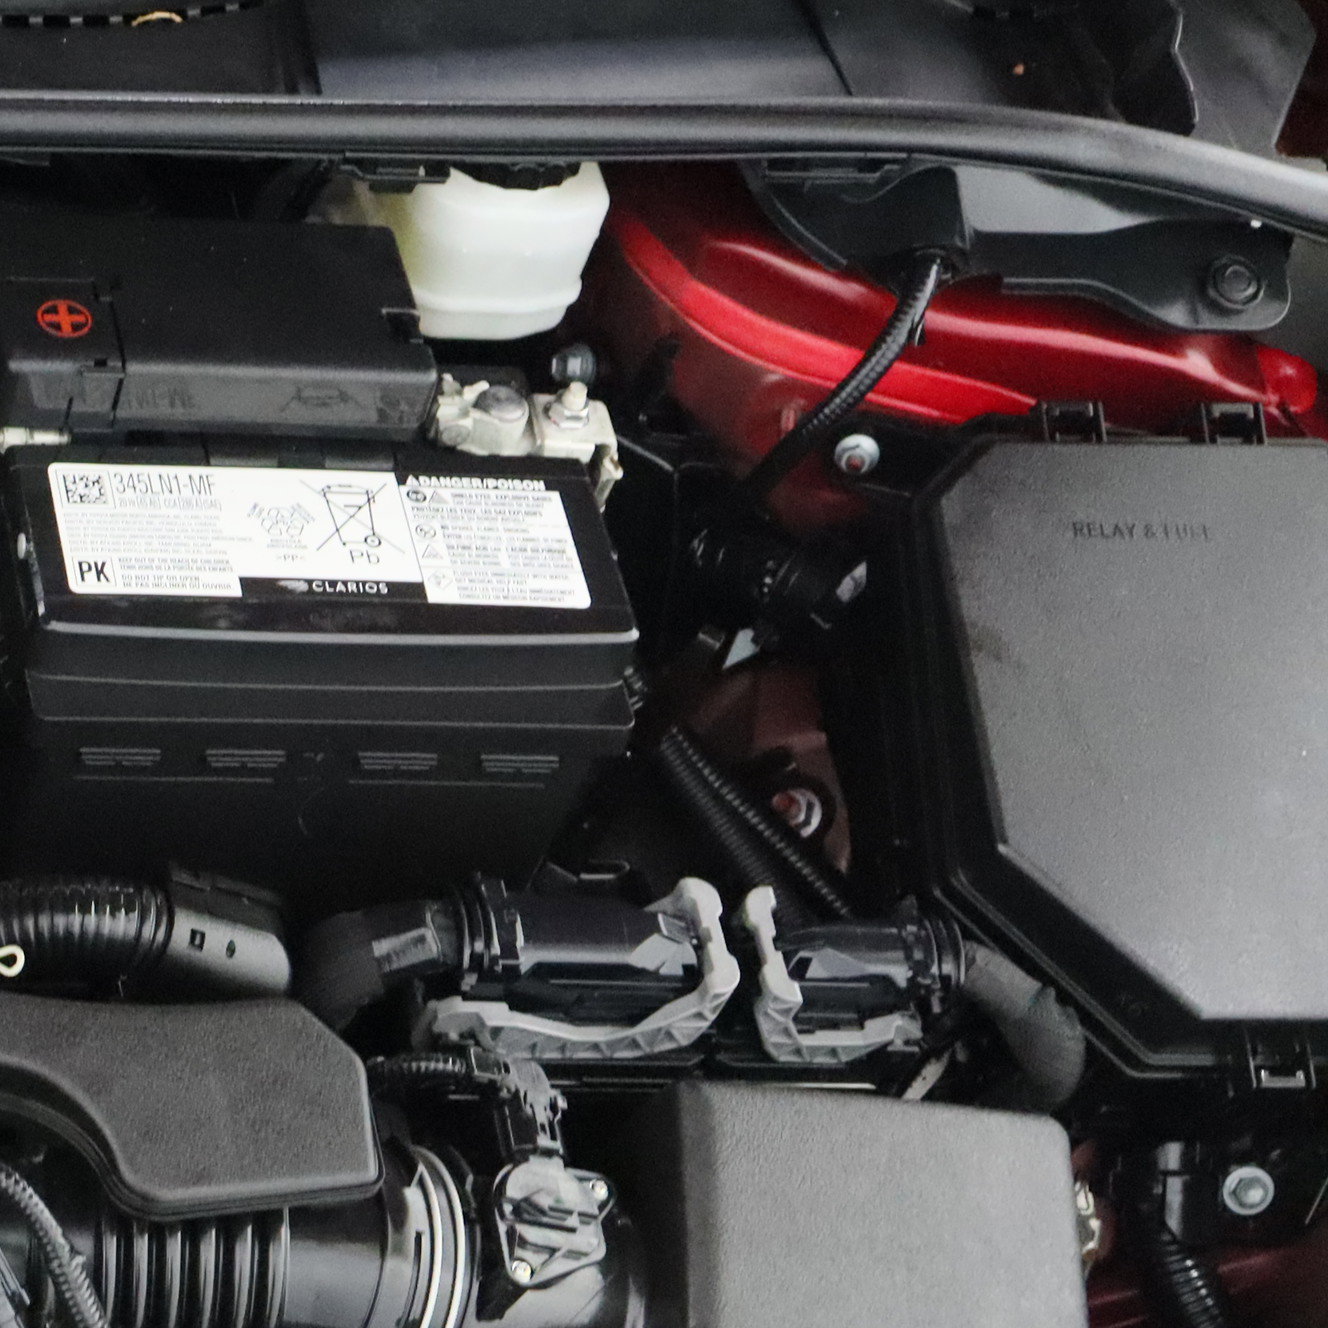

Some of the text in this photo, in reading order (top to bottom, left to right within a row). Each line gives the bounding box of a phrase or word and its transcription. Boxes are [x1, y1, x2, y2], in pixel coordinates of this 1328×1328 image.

[114, 473, 216, 495] 345LN1-MF
[418, 475, 546, 491] DANGER/POISON
[1072, 520, 1136, 540] RELAY
[350, 550, 381, 564] Pb
[77, 560, 111, 583] PK
[312, 580, 389, 594] CLARIOS
